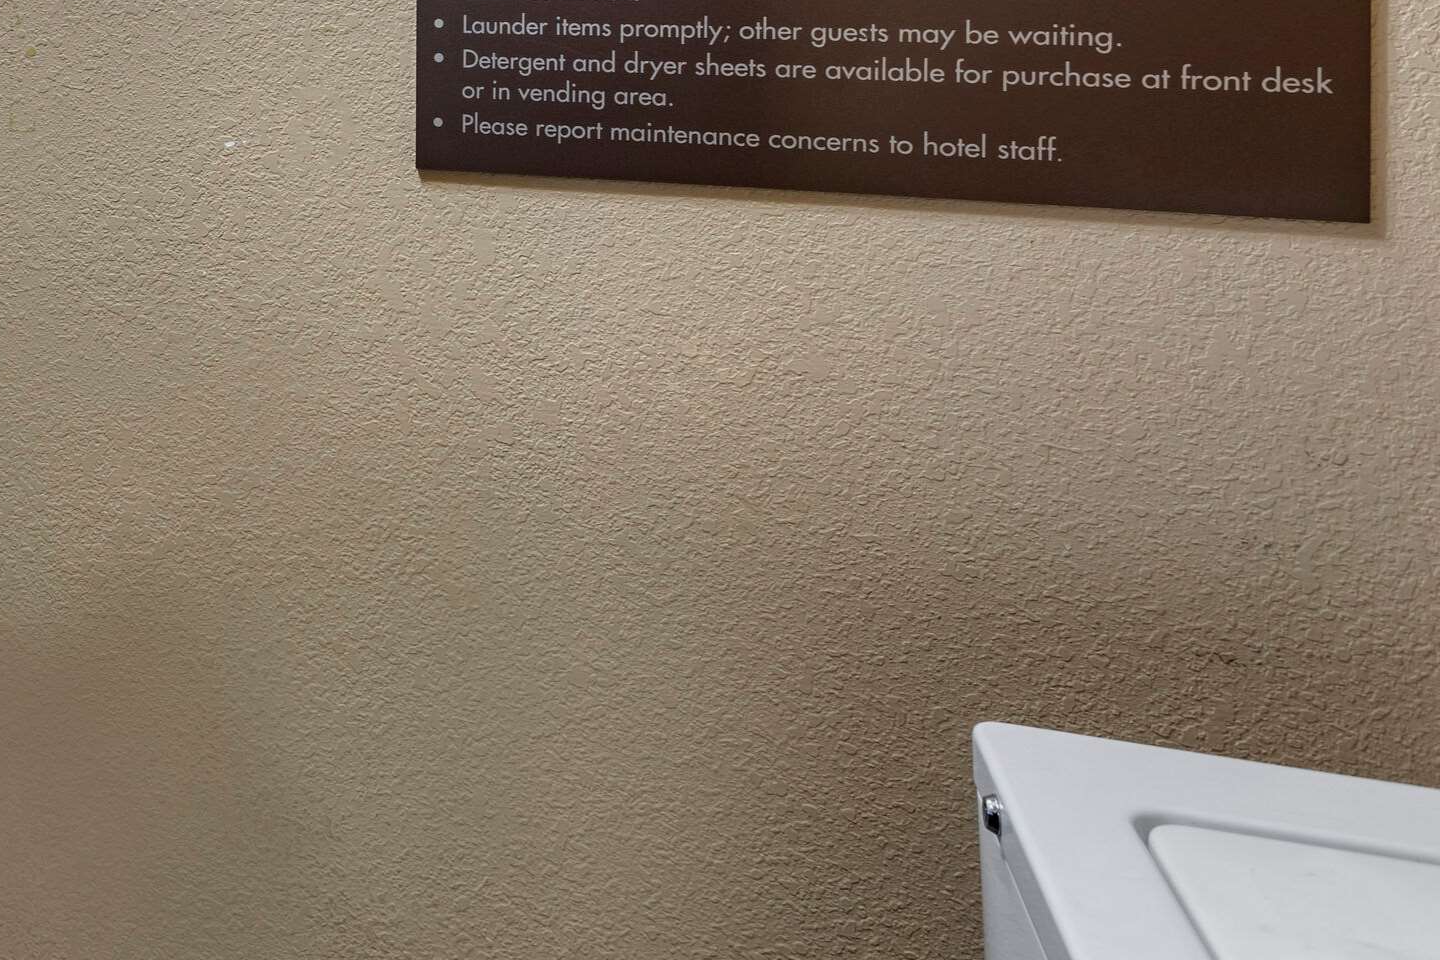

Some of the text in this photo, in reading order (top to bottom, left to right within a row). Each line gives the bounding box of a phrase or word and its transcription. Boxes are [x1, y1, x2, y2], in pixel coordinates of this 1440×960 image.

[462, 12, 1122, 55] Launder items promptly; other guests may be waiting.
[462, 48, 1334, 95] Detergent and dryer sheets are available for purchase at front desk
[461, 79, 674, 111] or in vending area.
[461, 111, 1063, 162] Please report maintenance concerns to hotel staff.
